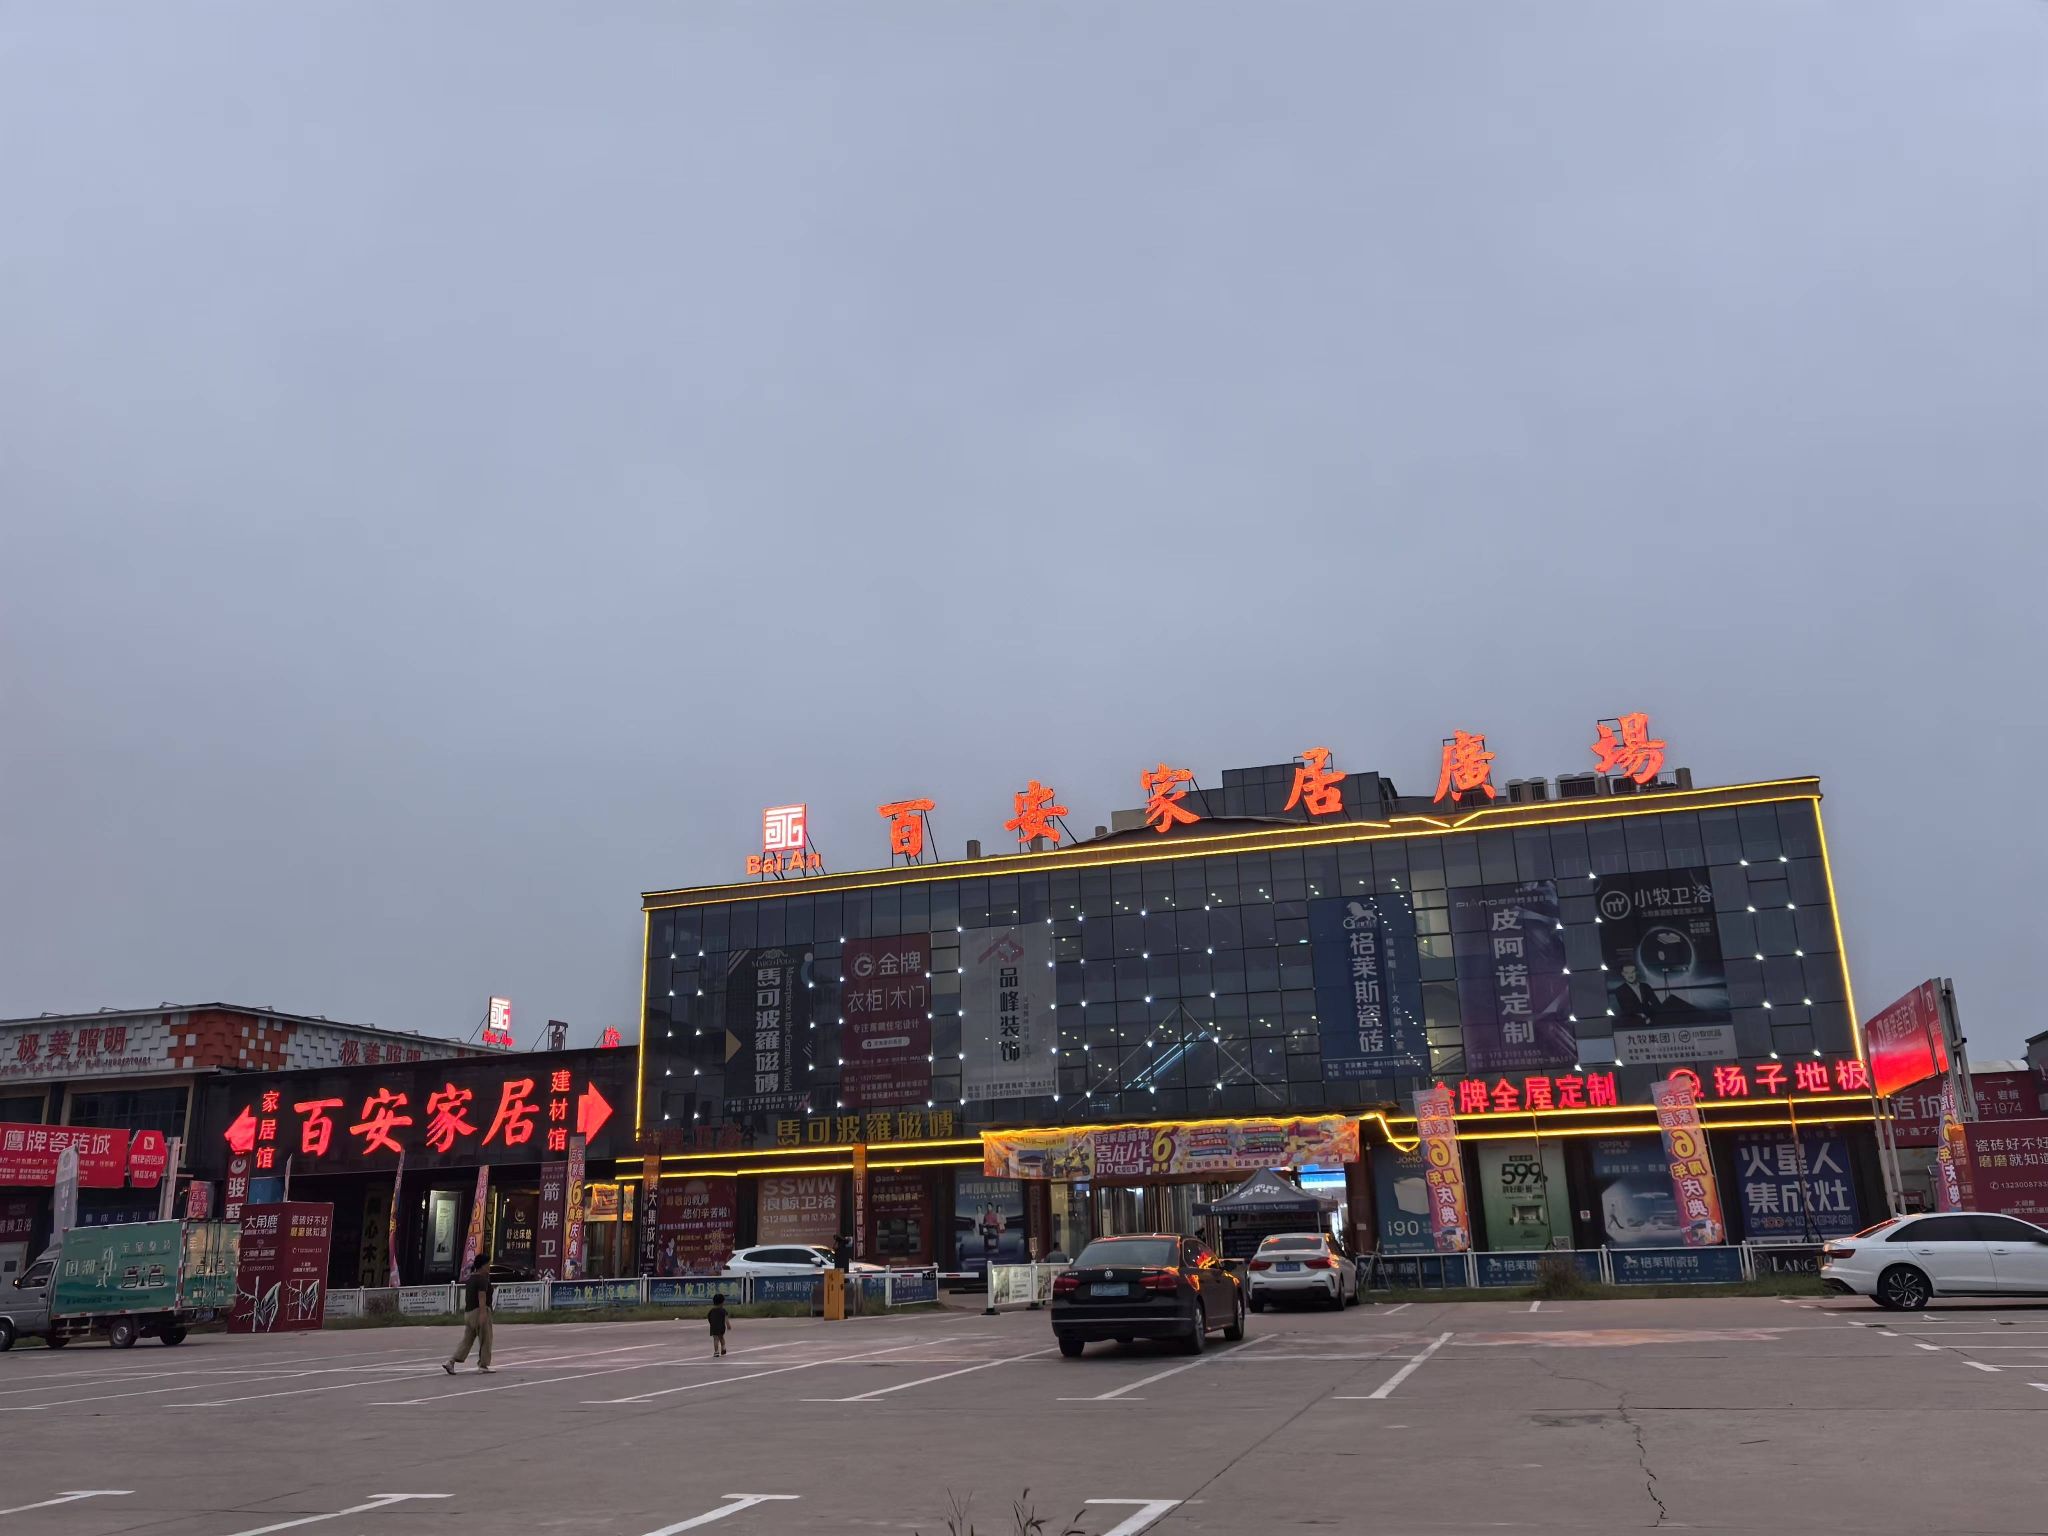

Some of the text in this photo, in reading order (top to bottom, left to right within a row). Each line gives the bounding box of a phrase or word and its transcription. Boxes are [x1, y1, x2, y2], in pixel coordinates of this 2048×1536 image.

[1634, 884, 1712, 908] 小牧卫浴
[879, 951, 921, 975] 金牌
[1491, 908, 1536, 1045] 皮阿诺定制
[848, 985, 925, 1013] 衣柜 木门
[1349, 932, 1384, 1053] 格莱斯瓷砖
[999, 967, 1021, 1062] 品峰装饰
[1715, 1060, 1870, 1098] 扬子地板
[294, 1077, 540, 1157] 百安家居
[548, 1069, 572, 1152] 建材馆
[256, 1090, 280, 1169] 家居馆
[1975, 1136, 2048, 1153] 瓷砖好不好
[1740, 1143, 1844, 1177] 火星人
[763, 1176, 836, 1196] SSWW
[763, 1195, 836, 1211] 浪鲸卫浴
[1746, 1179, 1851, 1214] 集成灶
[1388, 1220, 1419, 1236] i90
